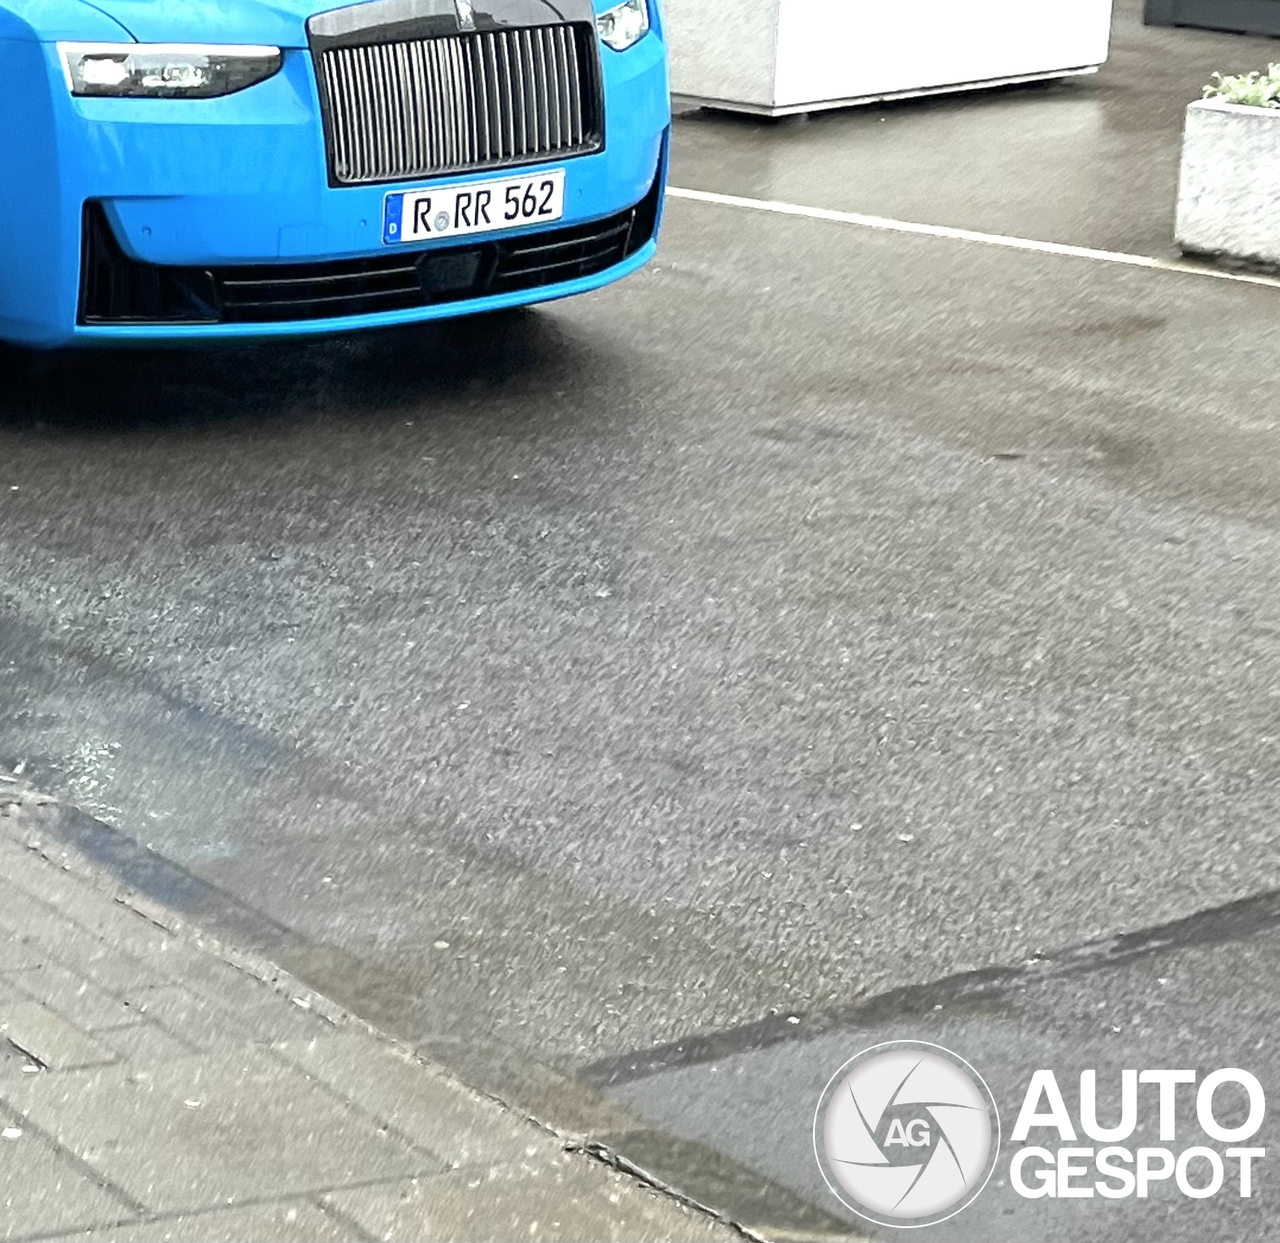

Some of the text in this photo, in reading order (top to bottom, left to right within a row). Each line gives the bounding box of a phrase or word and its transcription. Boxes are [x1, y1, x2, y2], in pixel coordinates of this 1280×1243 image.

[413, 180, 553, 233] R RR 562
[389, 222, 397, 235] D
